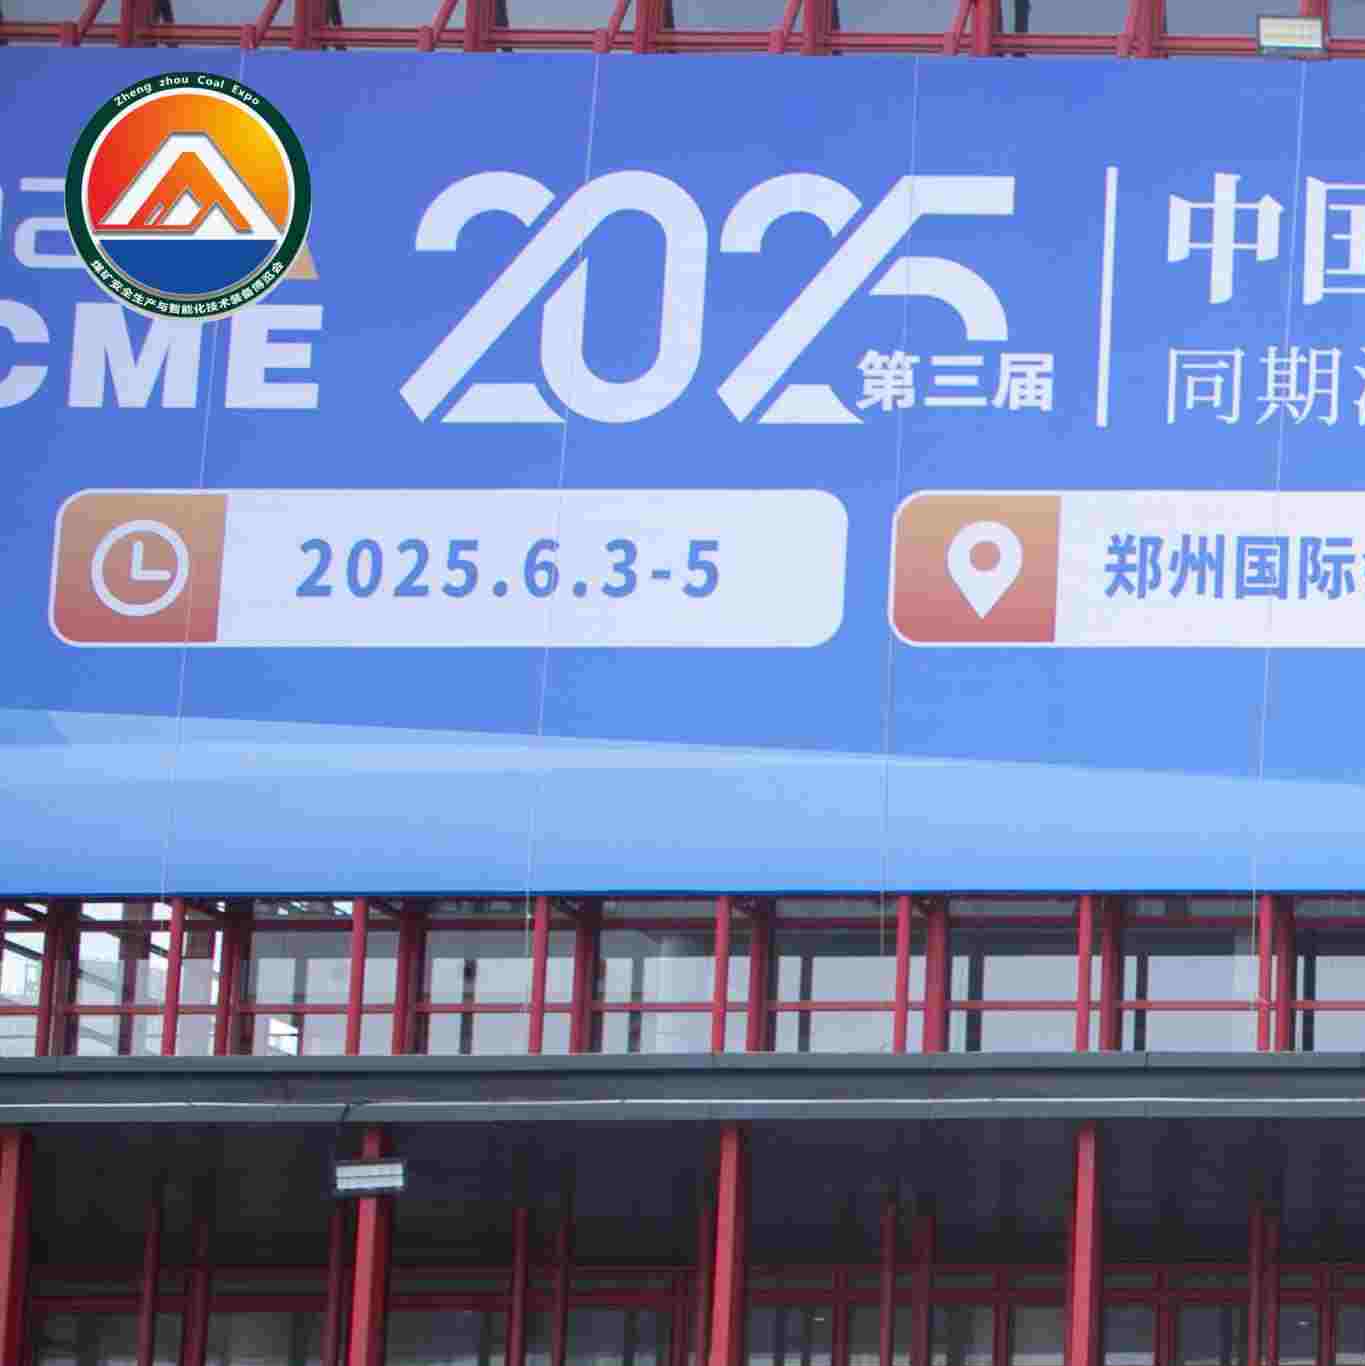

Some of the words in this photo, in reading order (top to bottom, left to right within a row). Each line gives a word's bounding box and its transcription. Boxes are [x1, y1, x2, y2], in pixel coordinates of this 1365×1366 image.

[399, 170, 1015, 425] 2025
[856, 350, 1055, 413] 第三届
[295, 537, 721, 599] 2025.6.3-5
